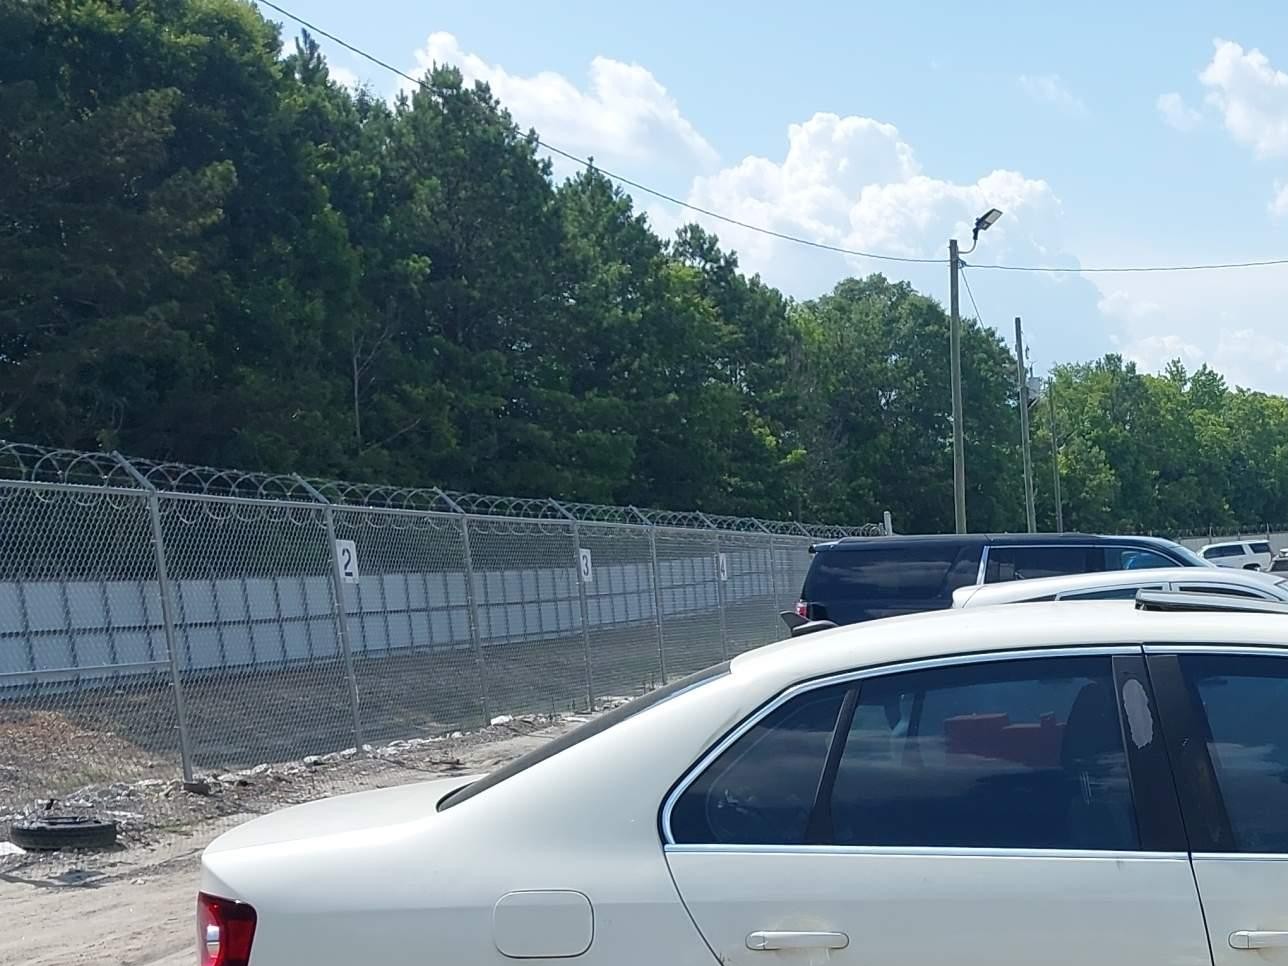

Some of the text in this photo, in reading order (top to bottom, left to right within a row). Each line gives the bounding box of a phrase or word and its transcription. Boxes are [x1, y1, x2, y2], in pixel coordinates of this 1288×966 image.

[341, 548, 353, 577] 2
[582, 554, 589, 577] 3
[720, 559, 726, 577] 4
